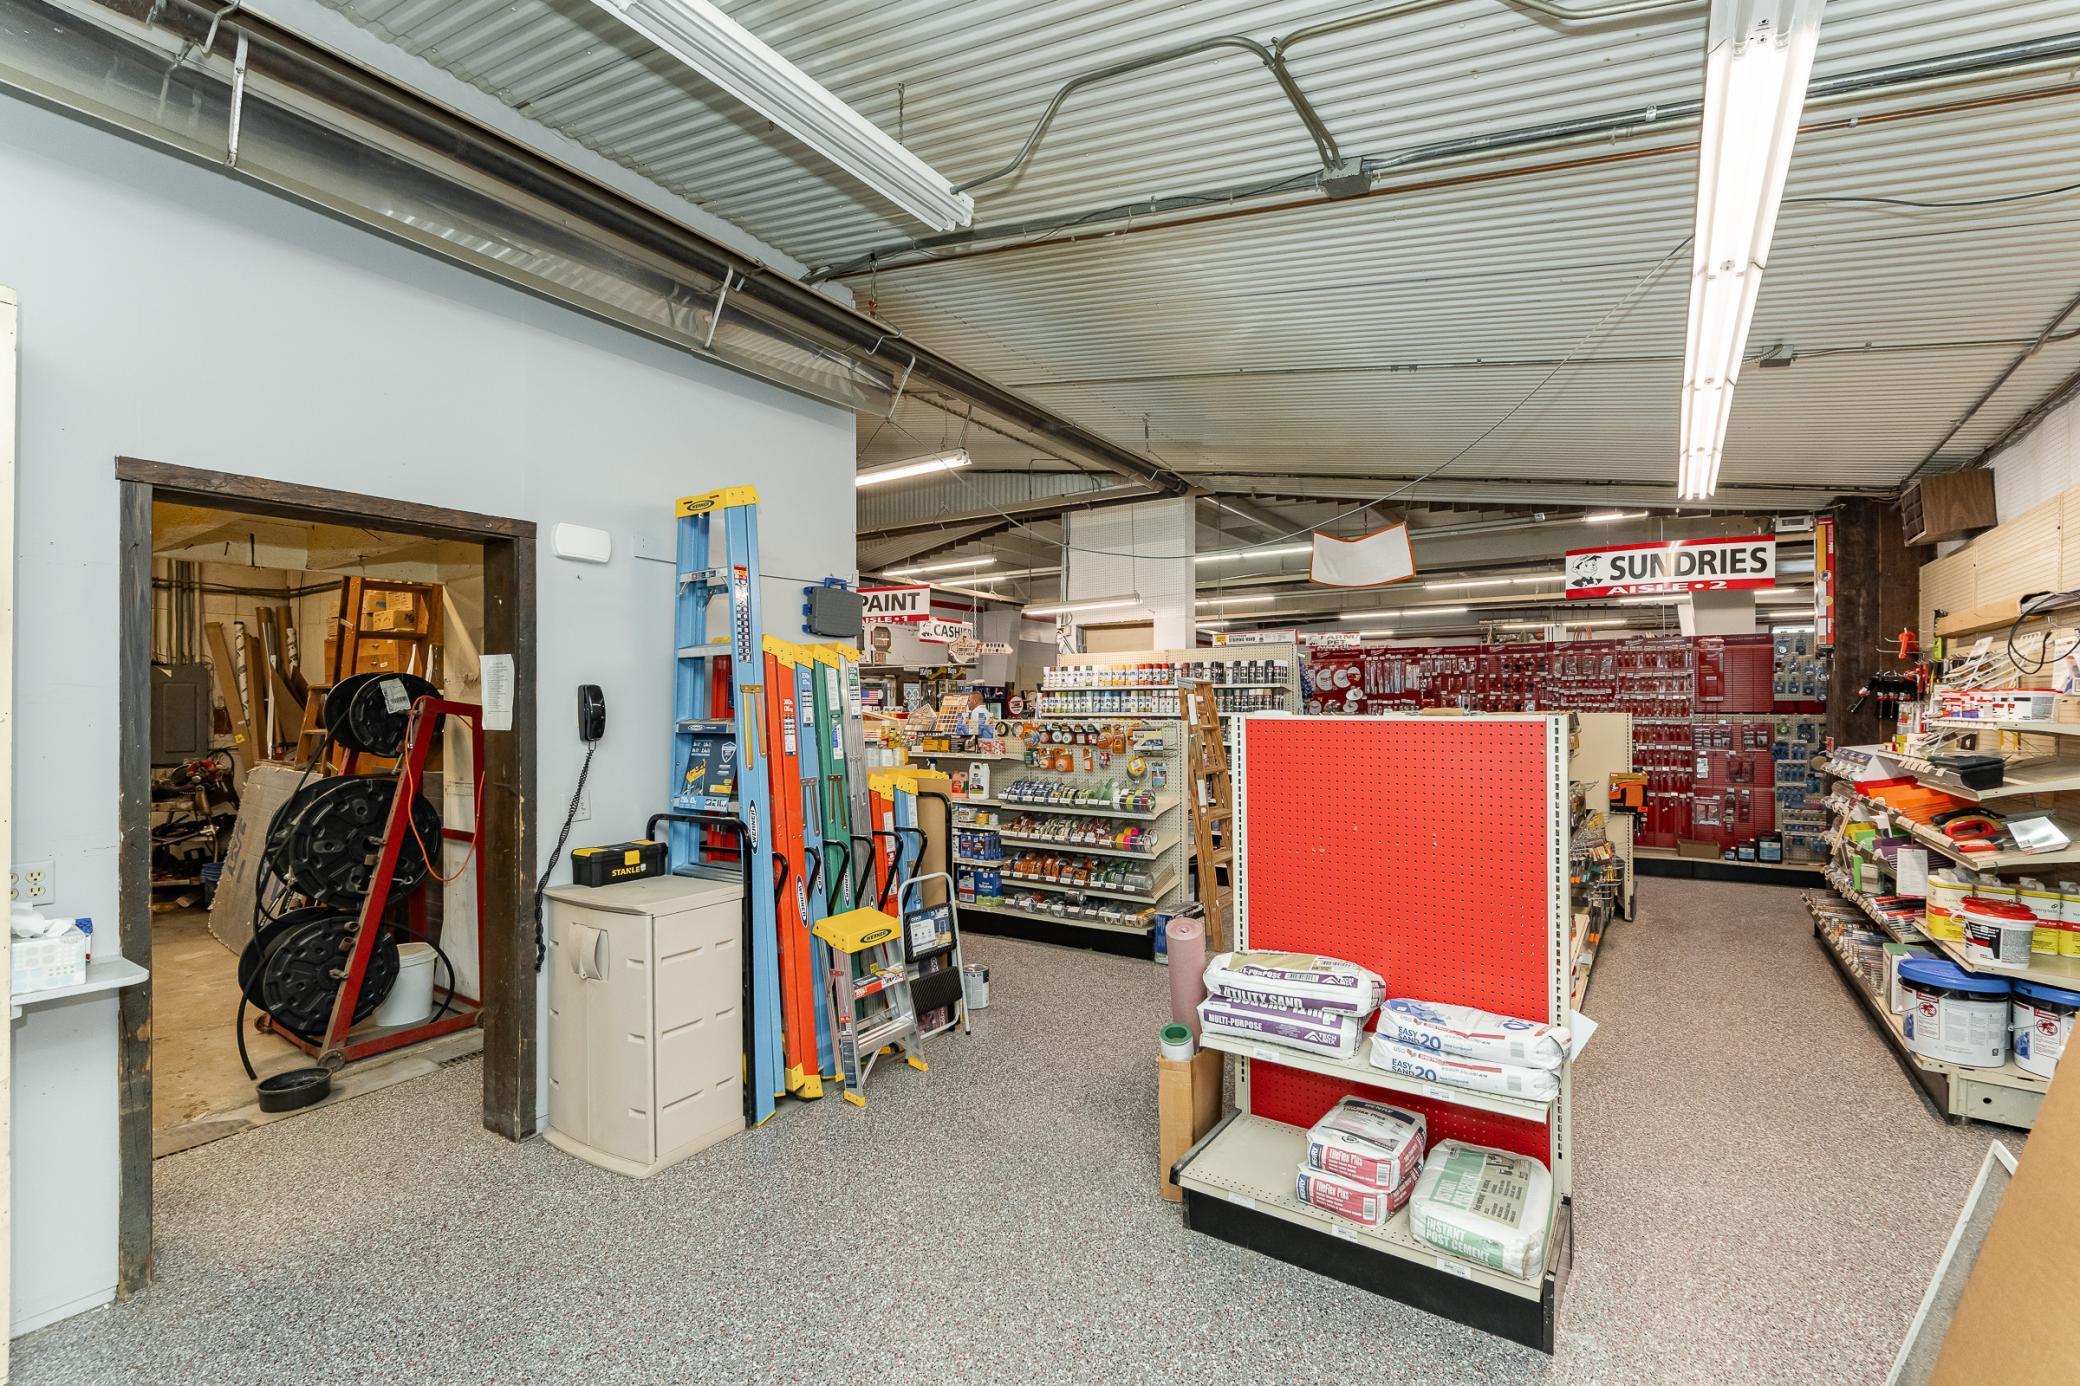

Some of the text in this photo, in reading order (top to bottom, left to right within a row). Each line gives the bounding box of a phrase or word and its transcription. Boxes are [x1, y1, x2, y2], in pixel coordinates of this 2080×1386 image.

[1609, 547, 1768, 581] SUNDRIES
[1606, 580, 1728, 595] AISLE 2
[611, 865, 642, 877] STANLE
[1208, 1013, 1263, 1032] MULTI-PURPOSE
[1398, 1026, 1418, 1038] EASY
[1420, 1033, 1442, 1050] 20
[1391, 1066, 1415, 1077] SAND
[1392, 1058, 1414, 1070] EASY
[1415, 1065, 1437, 1083] 20
[1426, 1216, 1465, 1242] INSTANT
[1426, 1228, 1490, 1262] POST CEMENT
